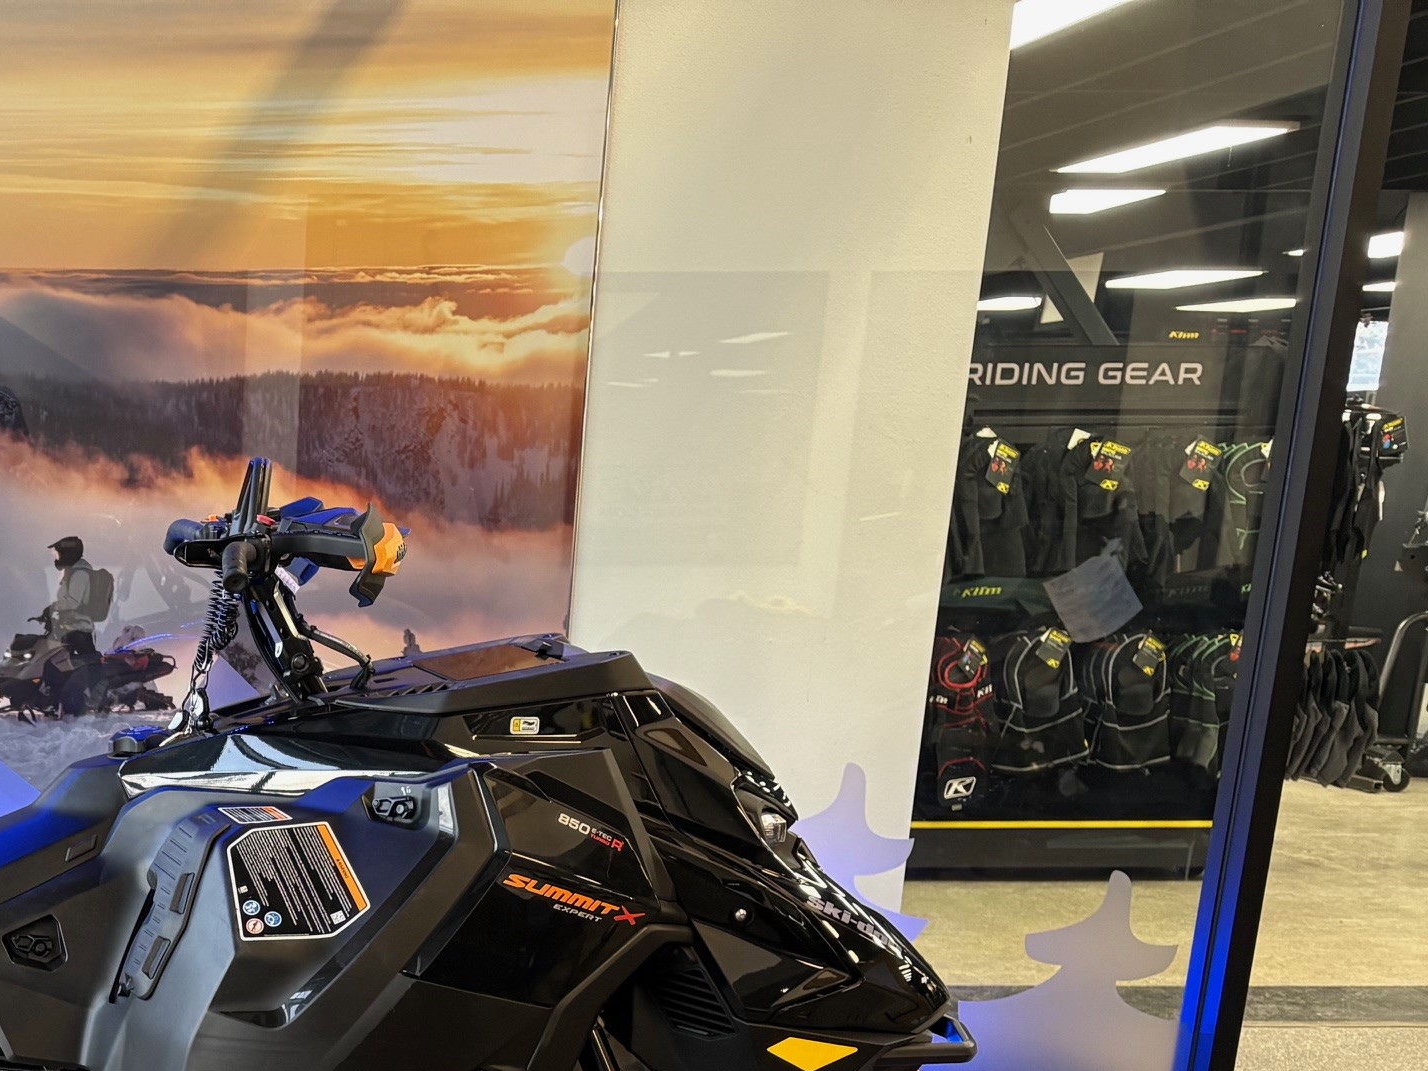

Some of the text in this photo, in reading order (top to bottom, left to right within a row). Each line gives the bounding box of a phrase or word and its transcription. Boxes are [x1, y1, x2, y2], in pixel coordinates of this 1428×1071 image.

[968, 362, 1203, 386] RIDING GEAR
[557, 812, 591, 836] 850
[591, 828, 613, 842] E-TEC
[502, 873, 646, 925] SUMMIT X
[552, 903, 603, 922] EXPERT
